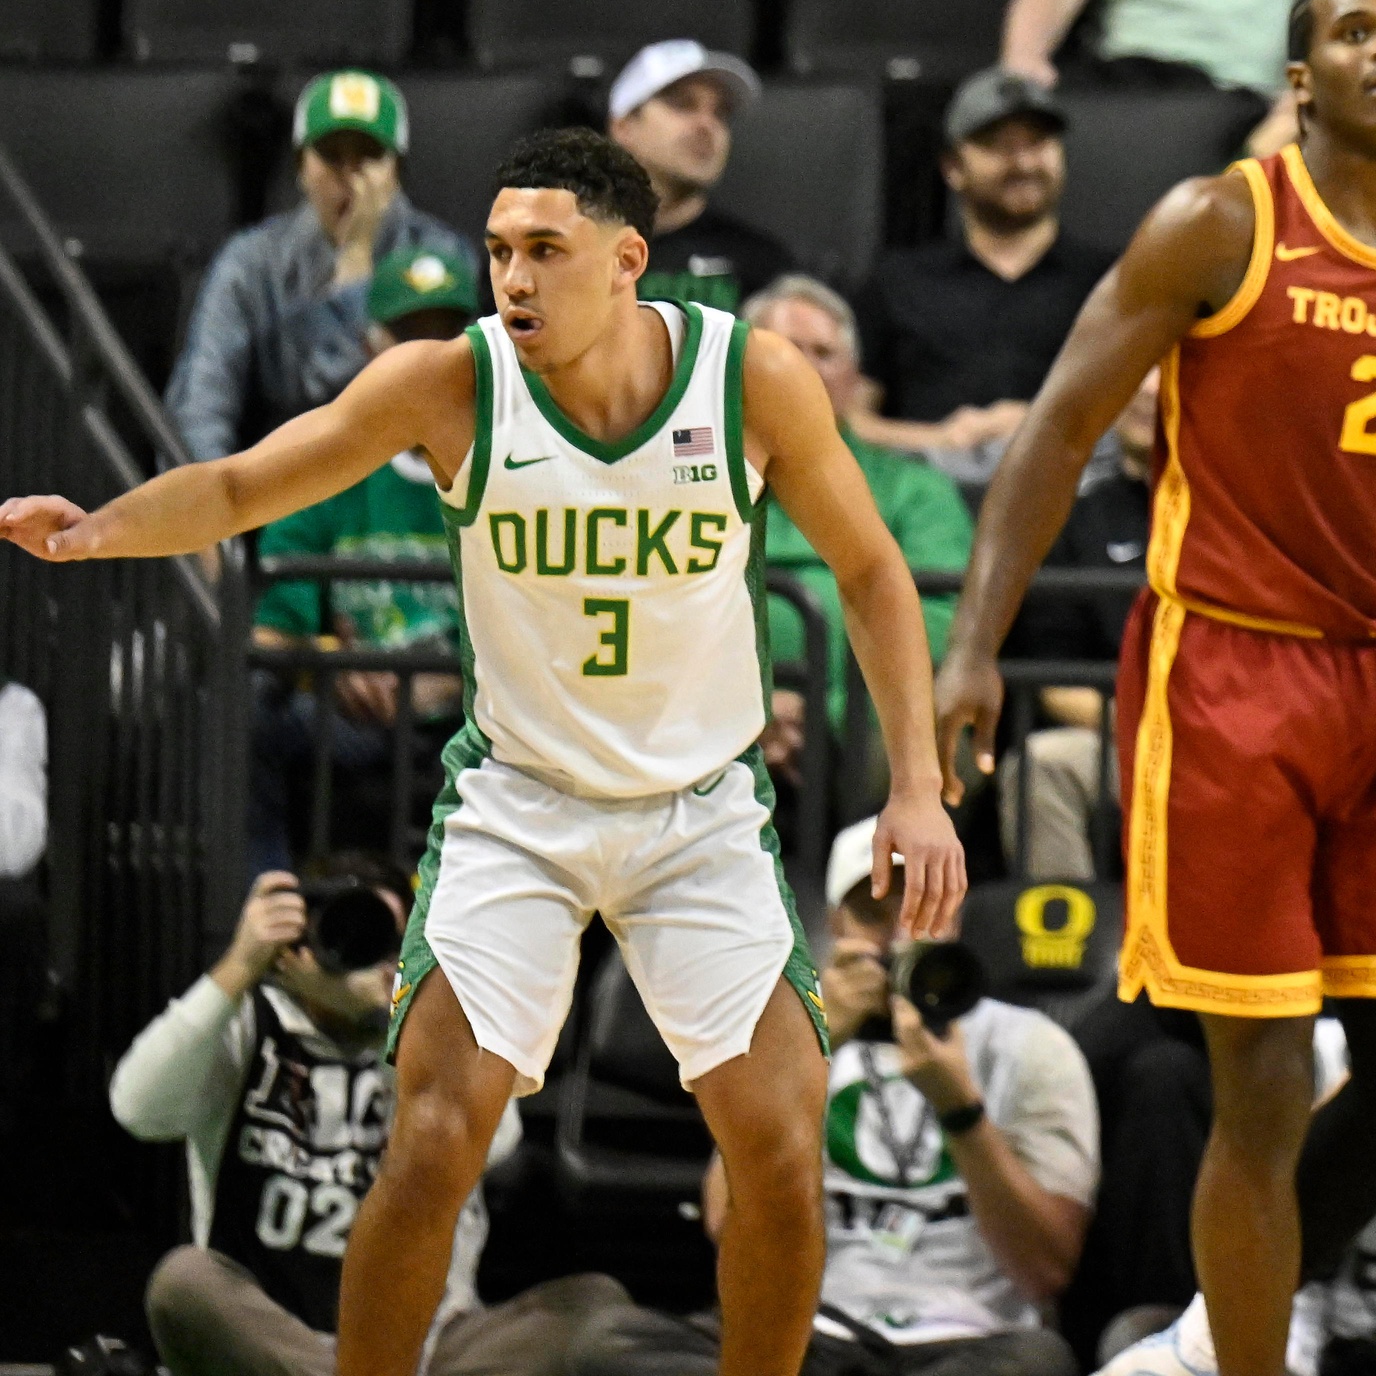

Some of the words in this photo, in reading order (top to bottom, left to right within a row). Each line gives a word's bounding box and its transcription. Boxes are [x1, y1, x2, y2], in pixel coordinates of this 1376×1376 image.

[487, 506, 729, 576] DUCKS
[581, 597, 631, 678] 3
[1014, 884, 1097, 939] O
